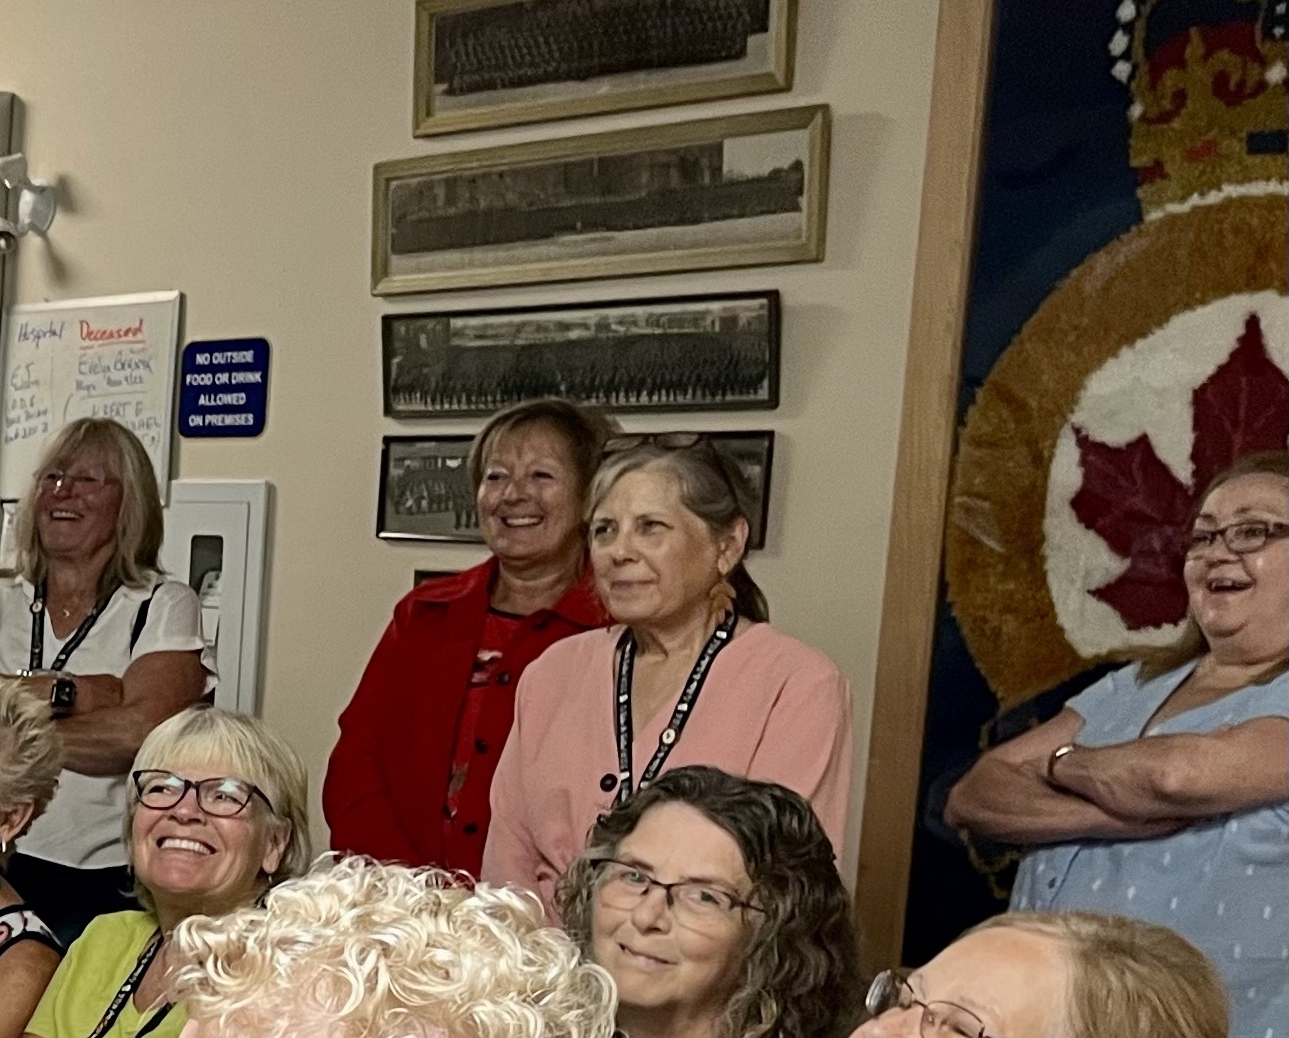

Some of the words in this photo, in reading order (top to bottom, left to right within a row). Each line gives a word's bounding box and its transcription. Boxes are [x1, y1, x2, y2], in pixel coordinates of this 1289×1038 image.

[78, 317, 144, 342] Deceased
[195, 352, 211, 366] NO
[212, 349, 254, 365] OUTSIDE
[185, 372, 213, 386] FOOD
[214, 371, 230, 385] OR
[231, 371, 262, 385] DRINK
[198, 392, 246, 406] ALLOWED
[188, 414, 203, 427] ON
[204, 413, 254, 426] PREMISES
